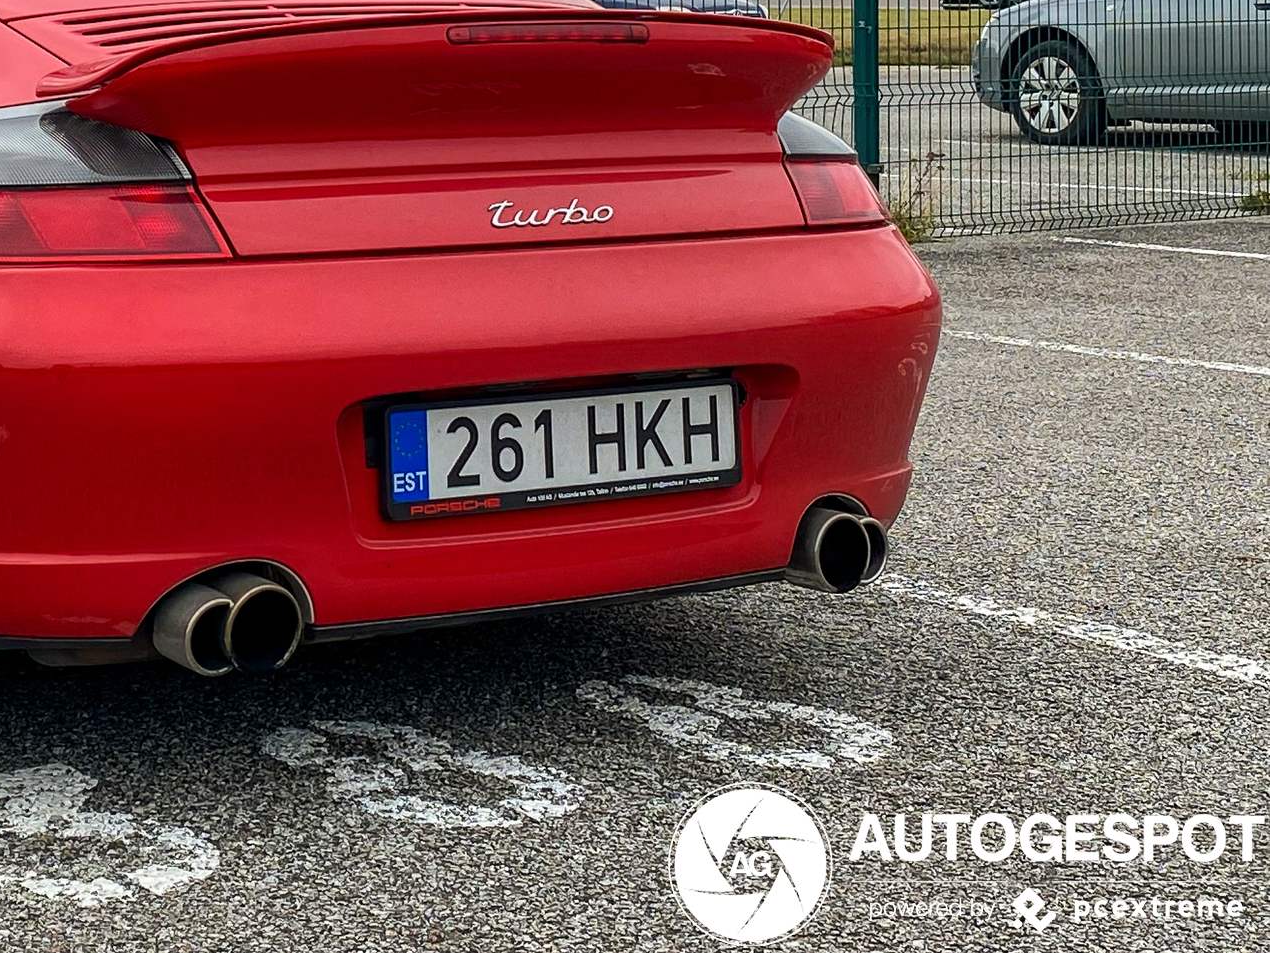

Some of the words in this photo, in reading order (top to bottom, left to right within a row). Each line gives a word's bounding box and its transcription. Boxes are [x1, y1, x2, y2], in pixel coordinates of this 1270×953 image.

[488, 198, 614, 228] turbo
[446, 409, 555, 488] 261
[587, 394, 720, 475] HKH
[393, 470, 427, 493] EST
[410, 498, 501, 517] PORSCHE
